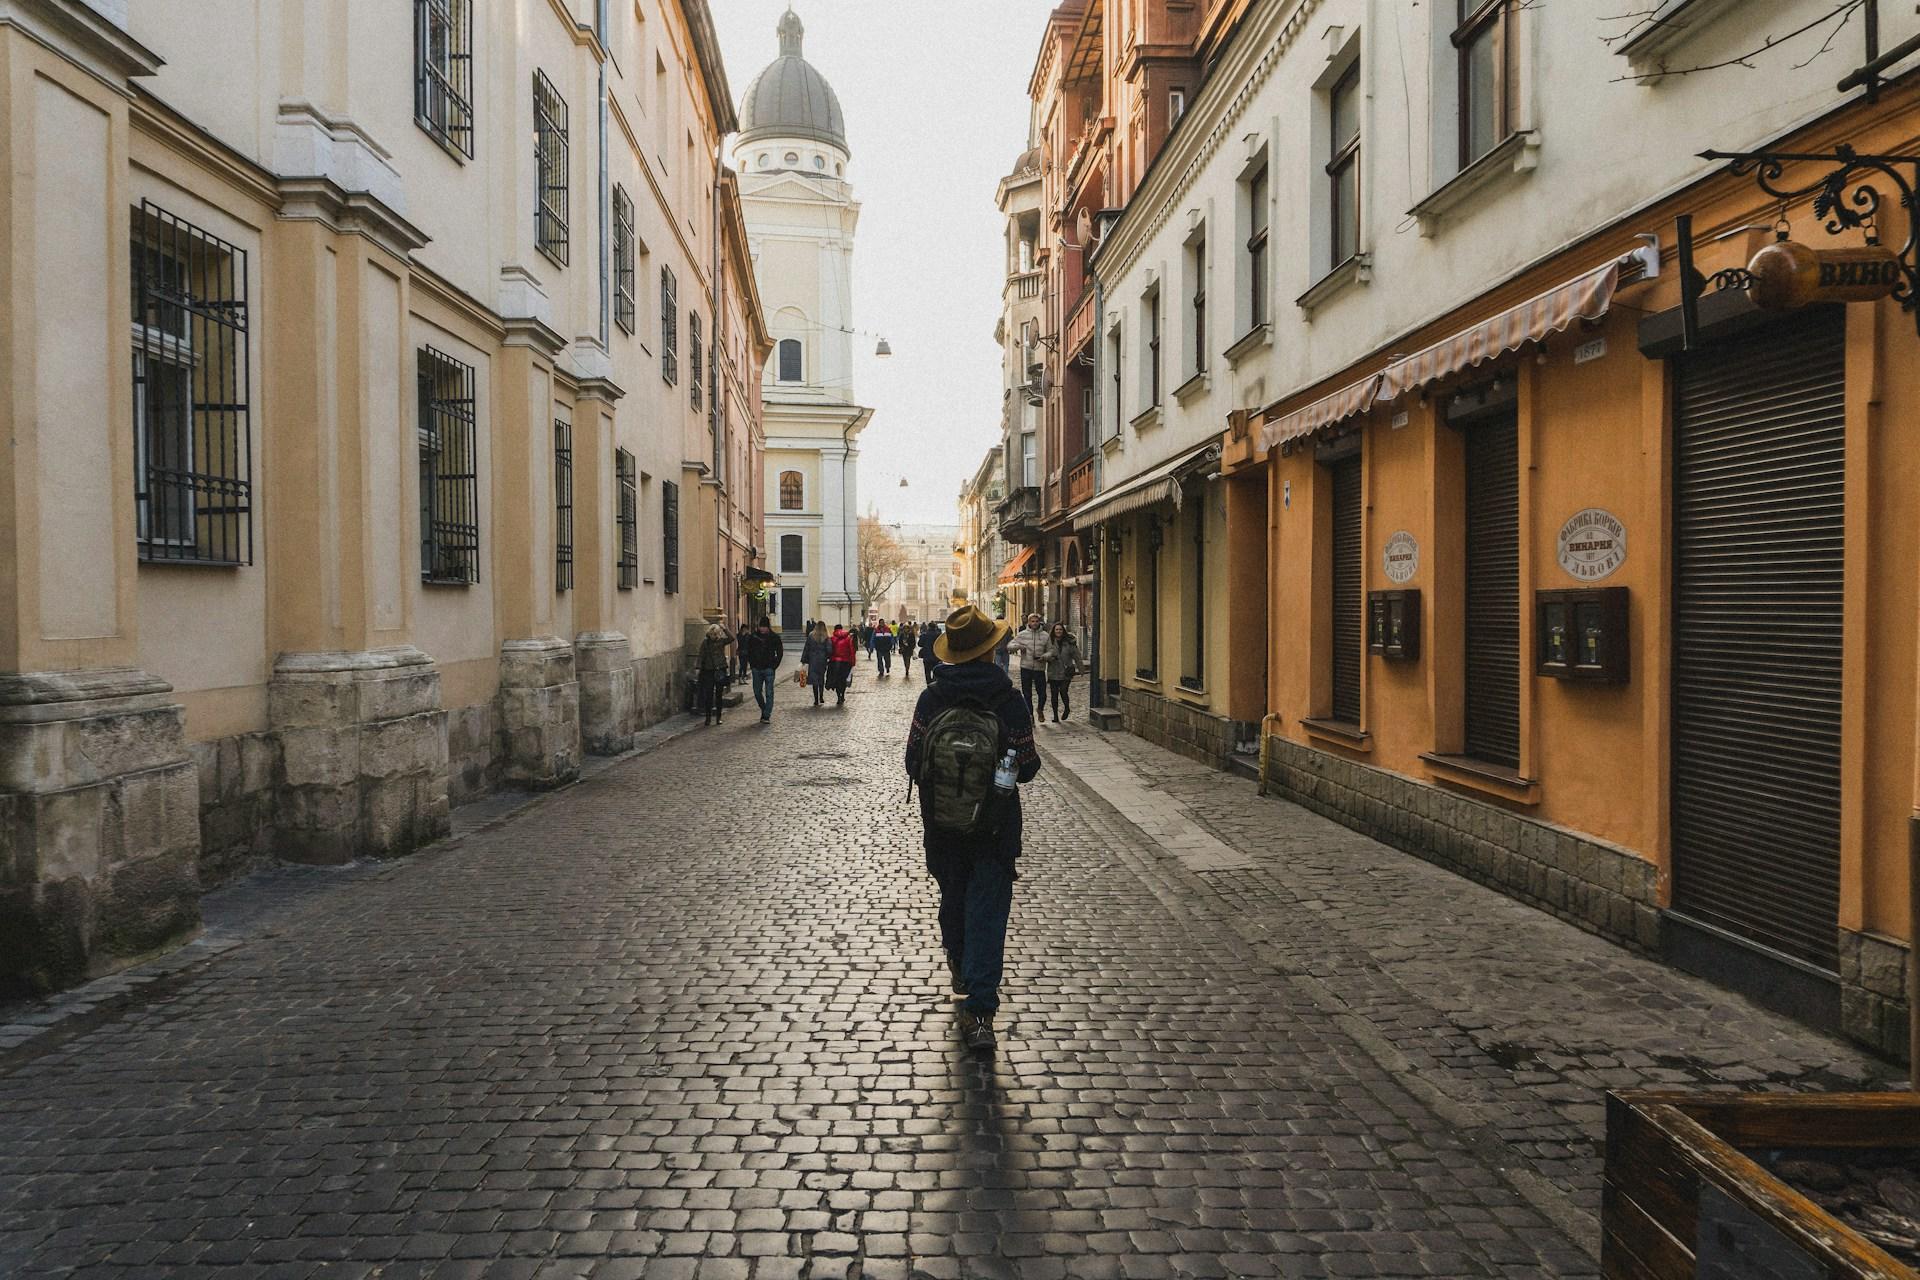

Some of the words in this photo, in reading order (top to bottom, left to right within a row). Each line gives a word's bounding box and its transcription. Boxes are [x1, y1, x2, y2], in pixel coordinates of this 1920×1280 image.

[1819, 261, 1900, 287] ВИНО
[1569, 540, 1613, 552] ВИНАРНЯ
[1572, 551, 1620, 577] ЛЬВОВІ
